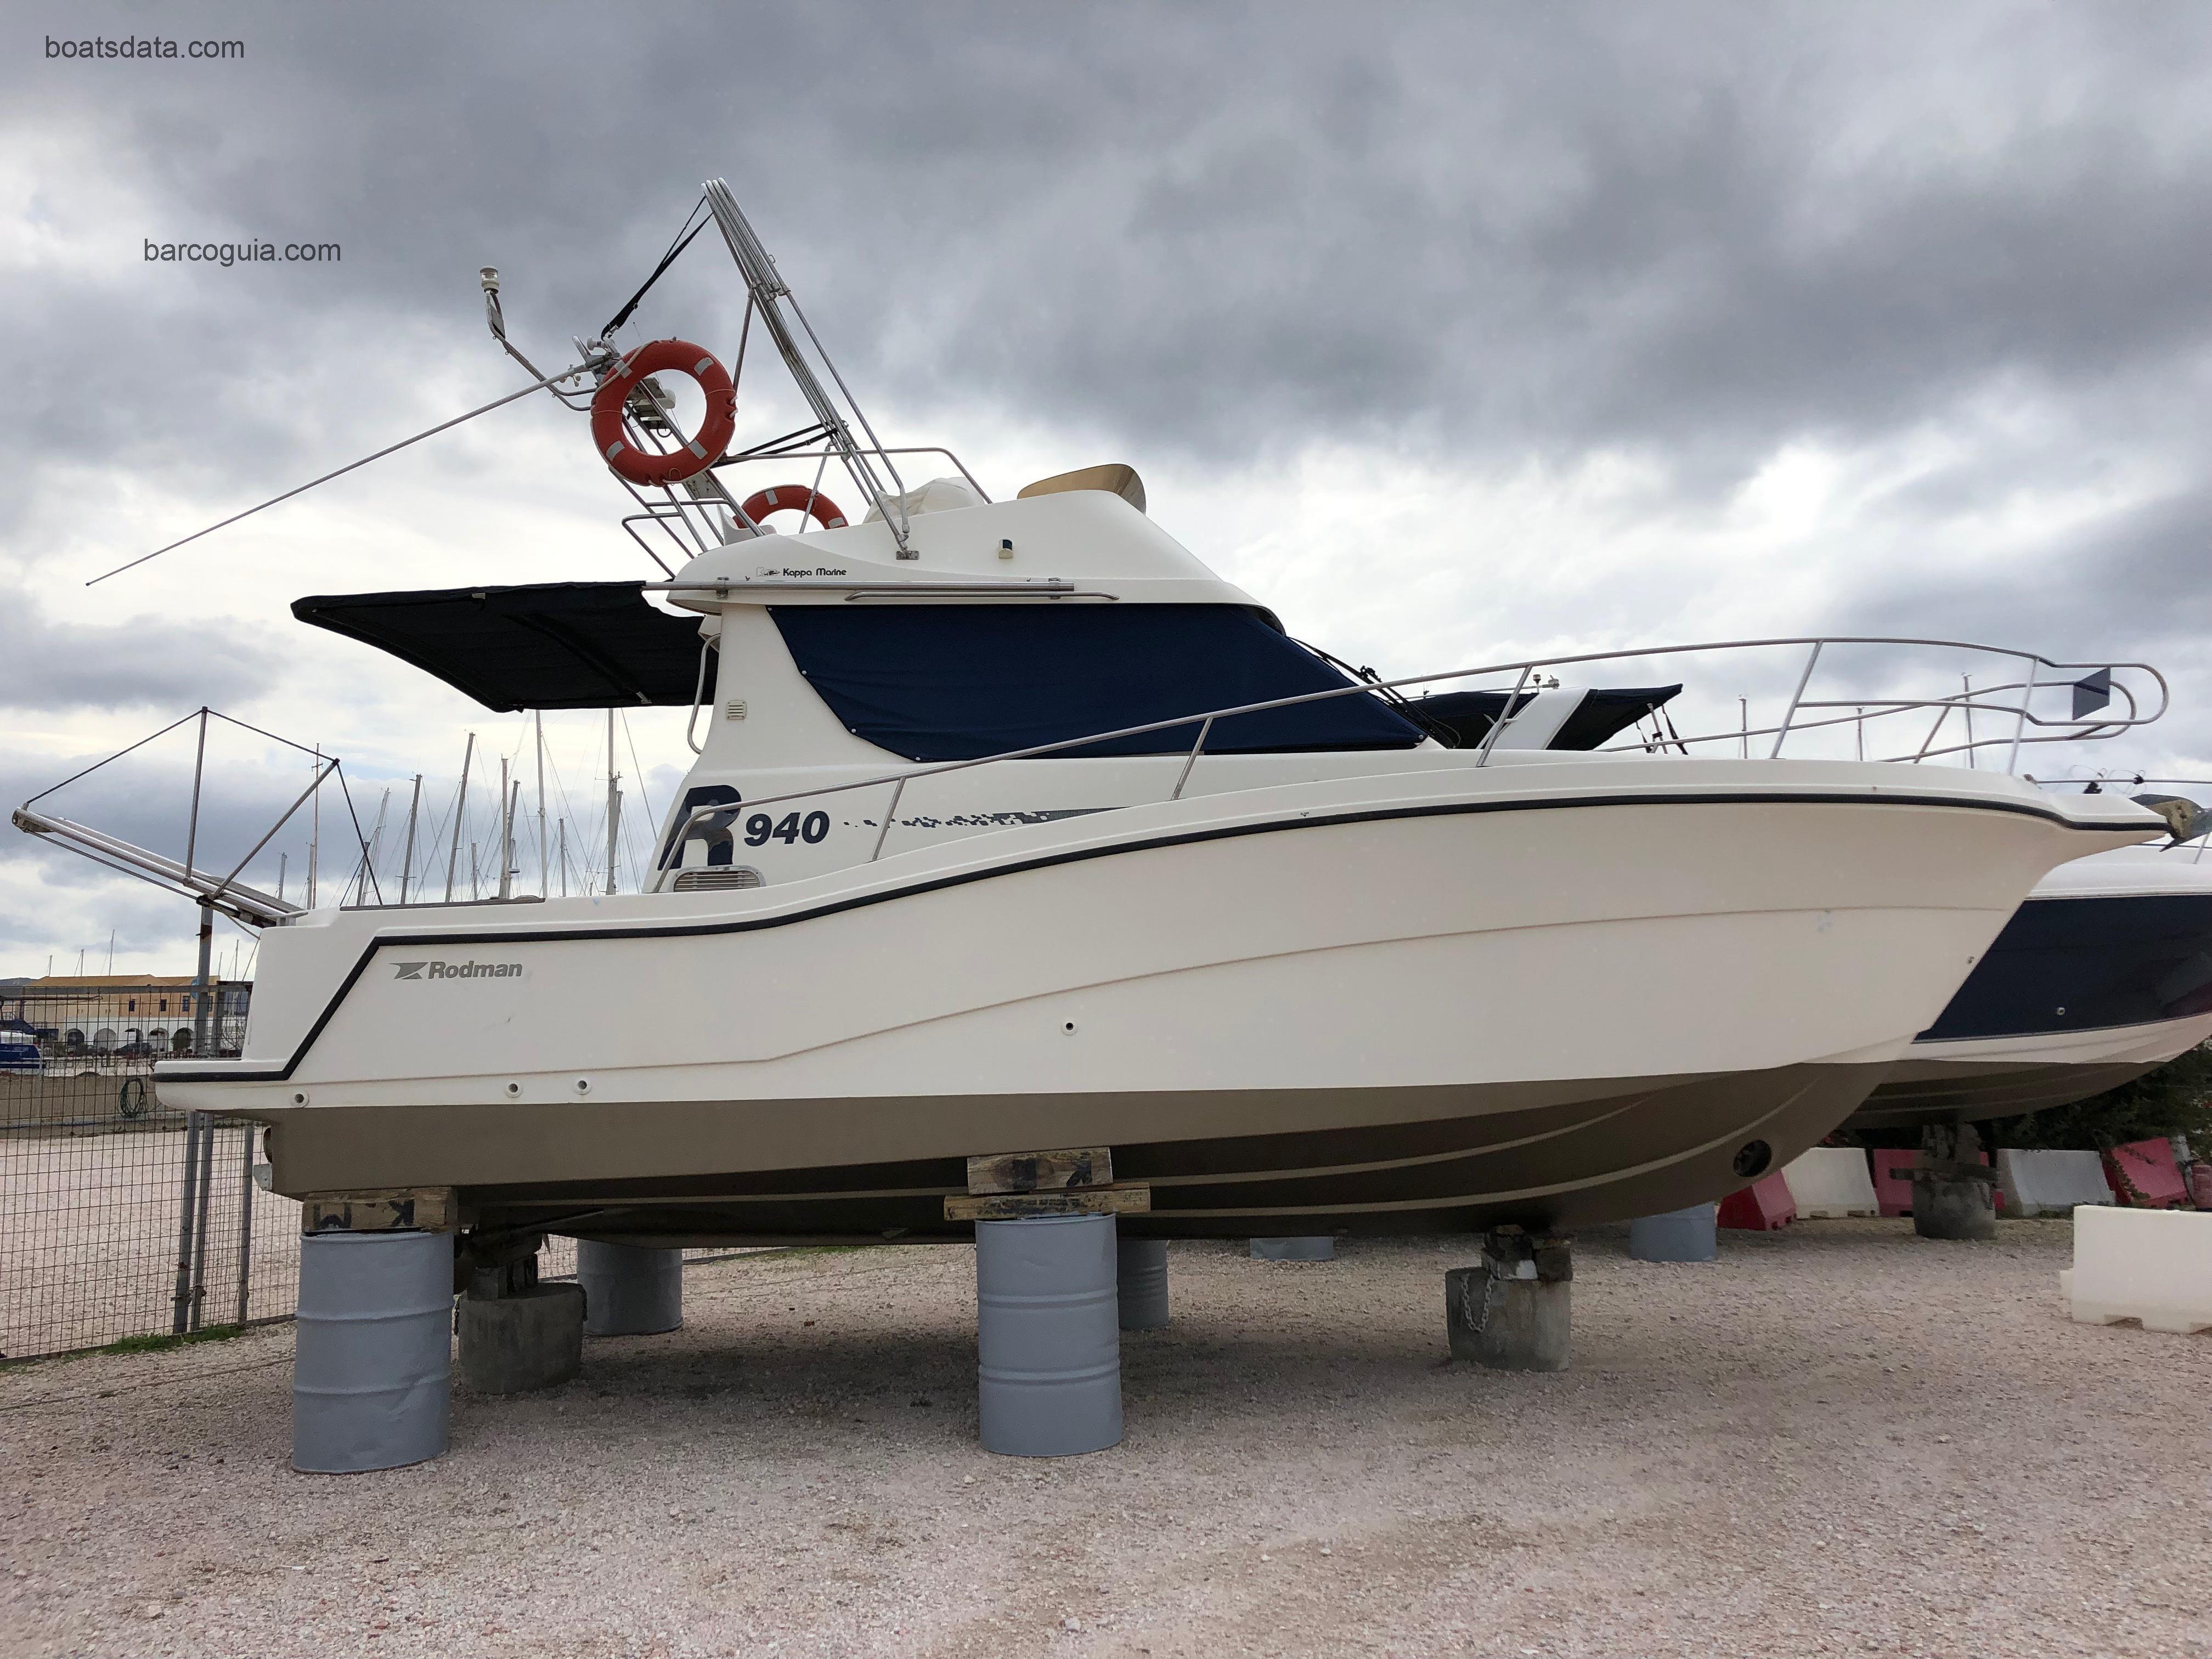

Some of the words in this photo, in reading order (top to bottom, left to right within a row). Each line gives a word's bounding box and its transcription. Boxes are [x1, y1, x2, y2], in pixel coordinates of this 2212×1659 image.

[783, 568, 812, 578] Kappa
[816, 568, 847, 576] Marine
[657, 785, 742, 870] R
[744, 810, 830, 847] 940
[428, 961, 523, 979] Rodman
